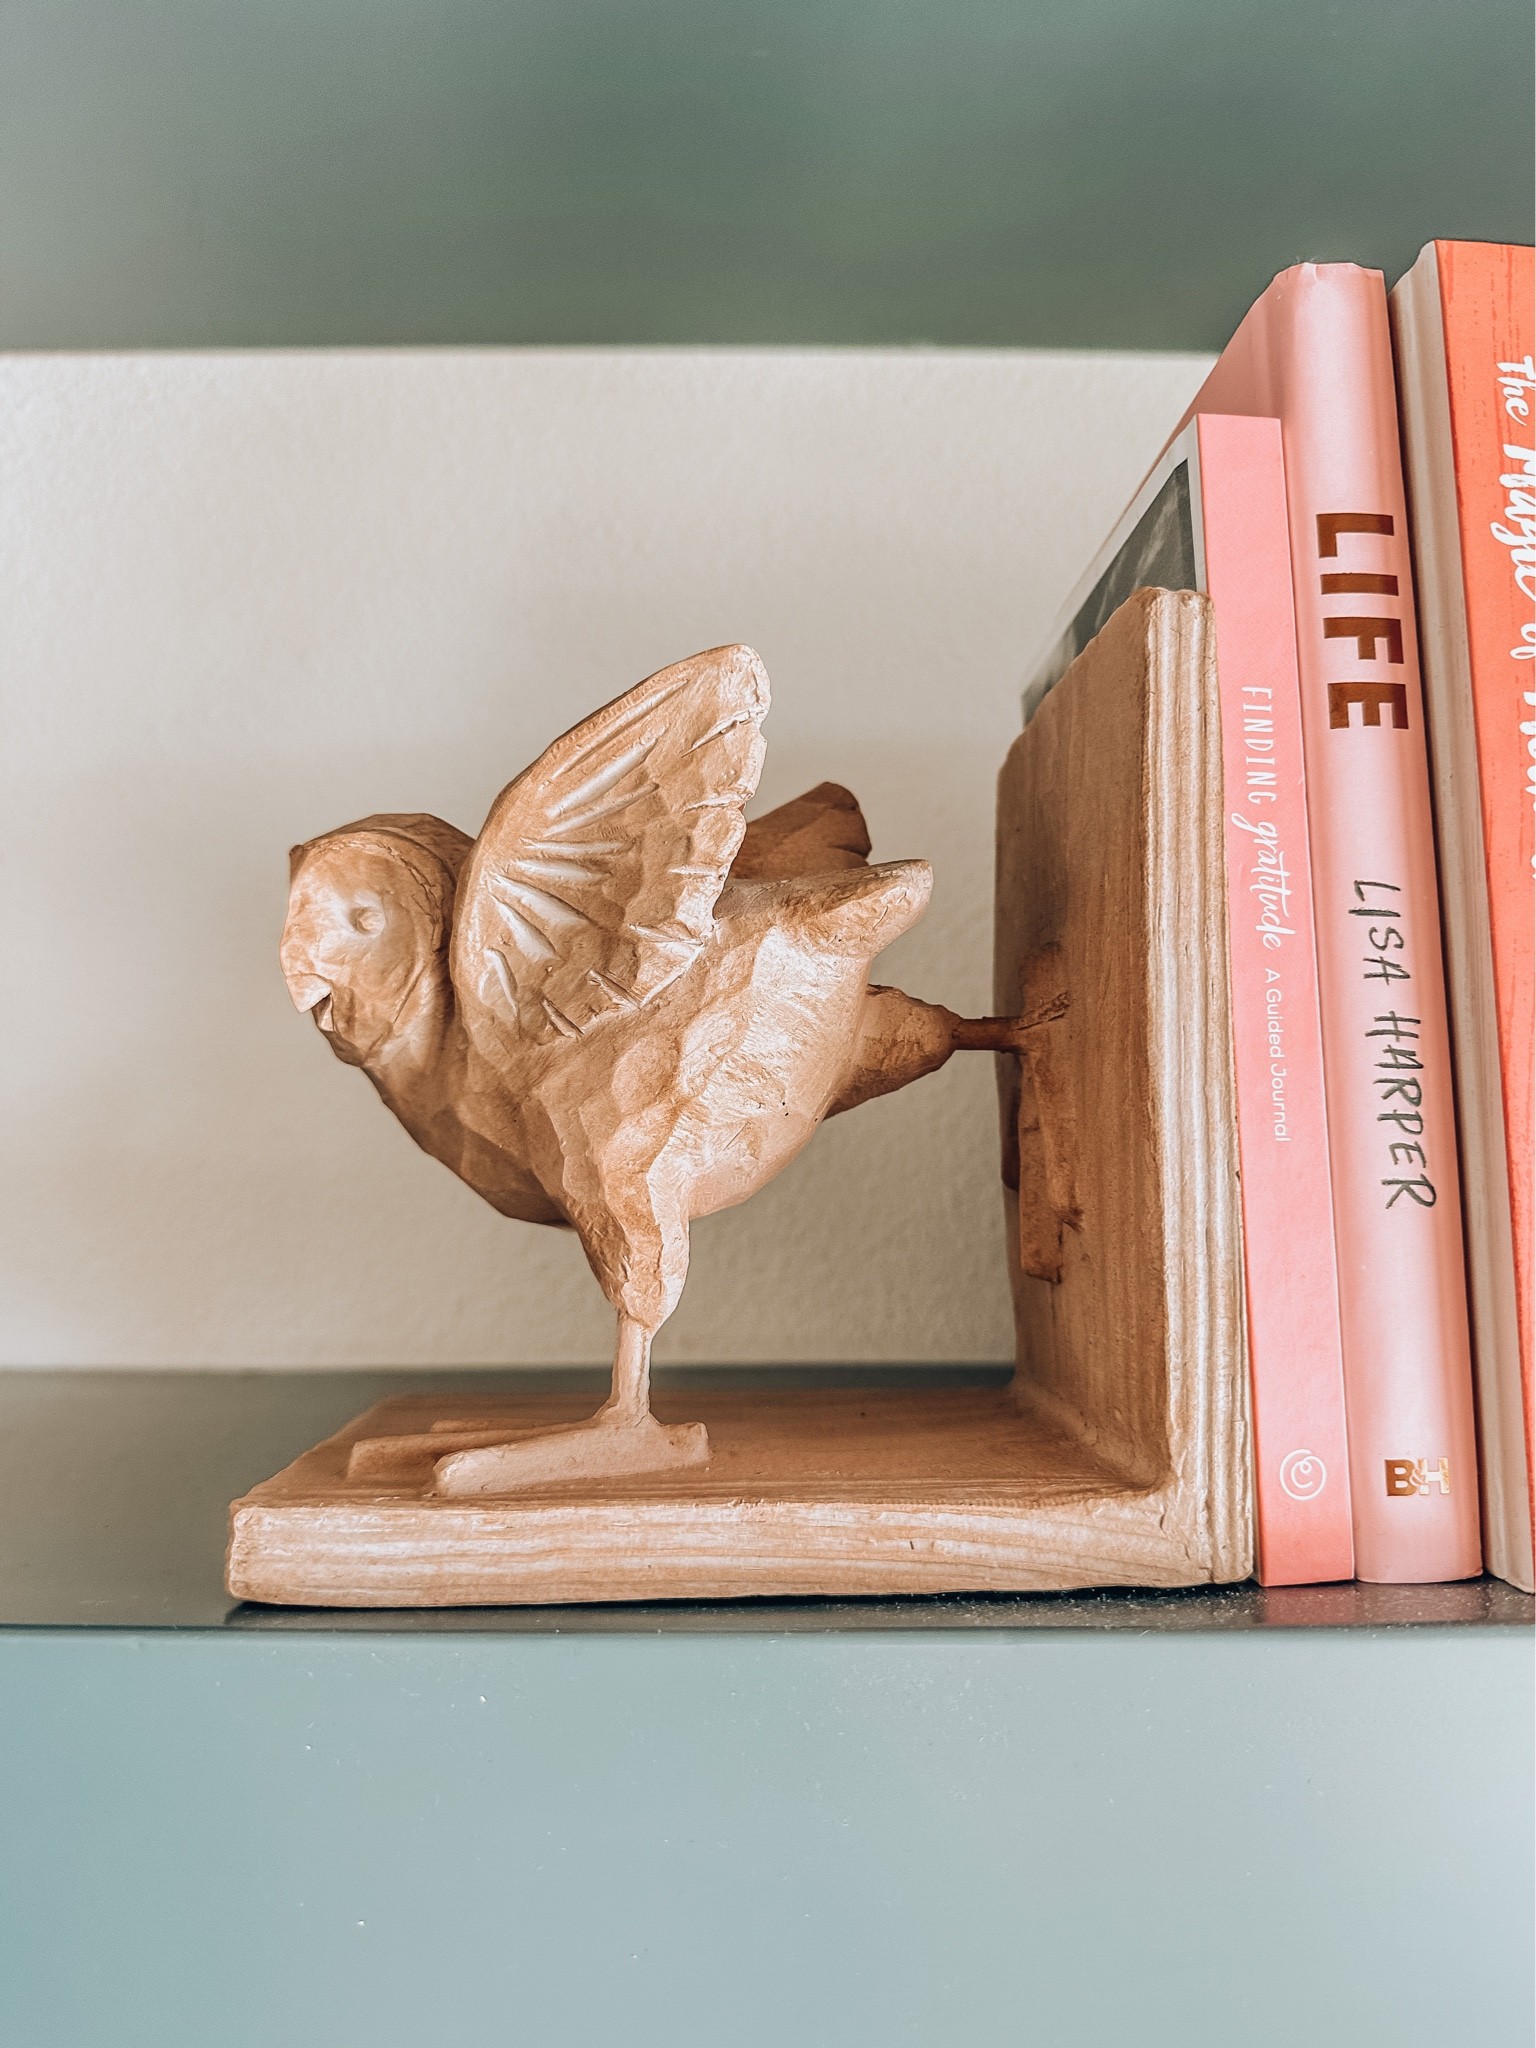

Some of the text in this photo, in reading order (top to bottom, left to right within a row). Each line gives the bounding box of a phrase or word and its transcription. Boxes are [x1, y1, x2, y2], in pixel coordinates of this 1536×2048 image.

[1496, 355, 1536, 427] The
[1316, 513, 1409, 730] LIFE
[1231, 686, 1296, 1142] FINDING gratitude A Guided Journal
[1348, 879, 1437, 1210] LISA HARPER
[1384, 1457, 1450, 1497] B&H
